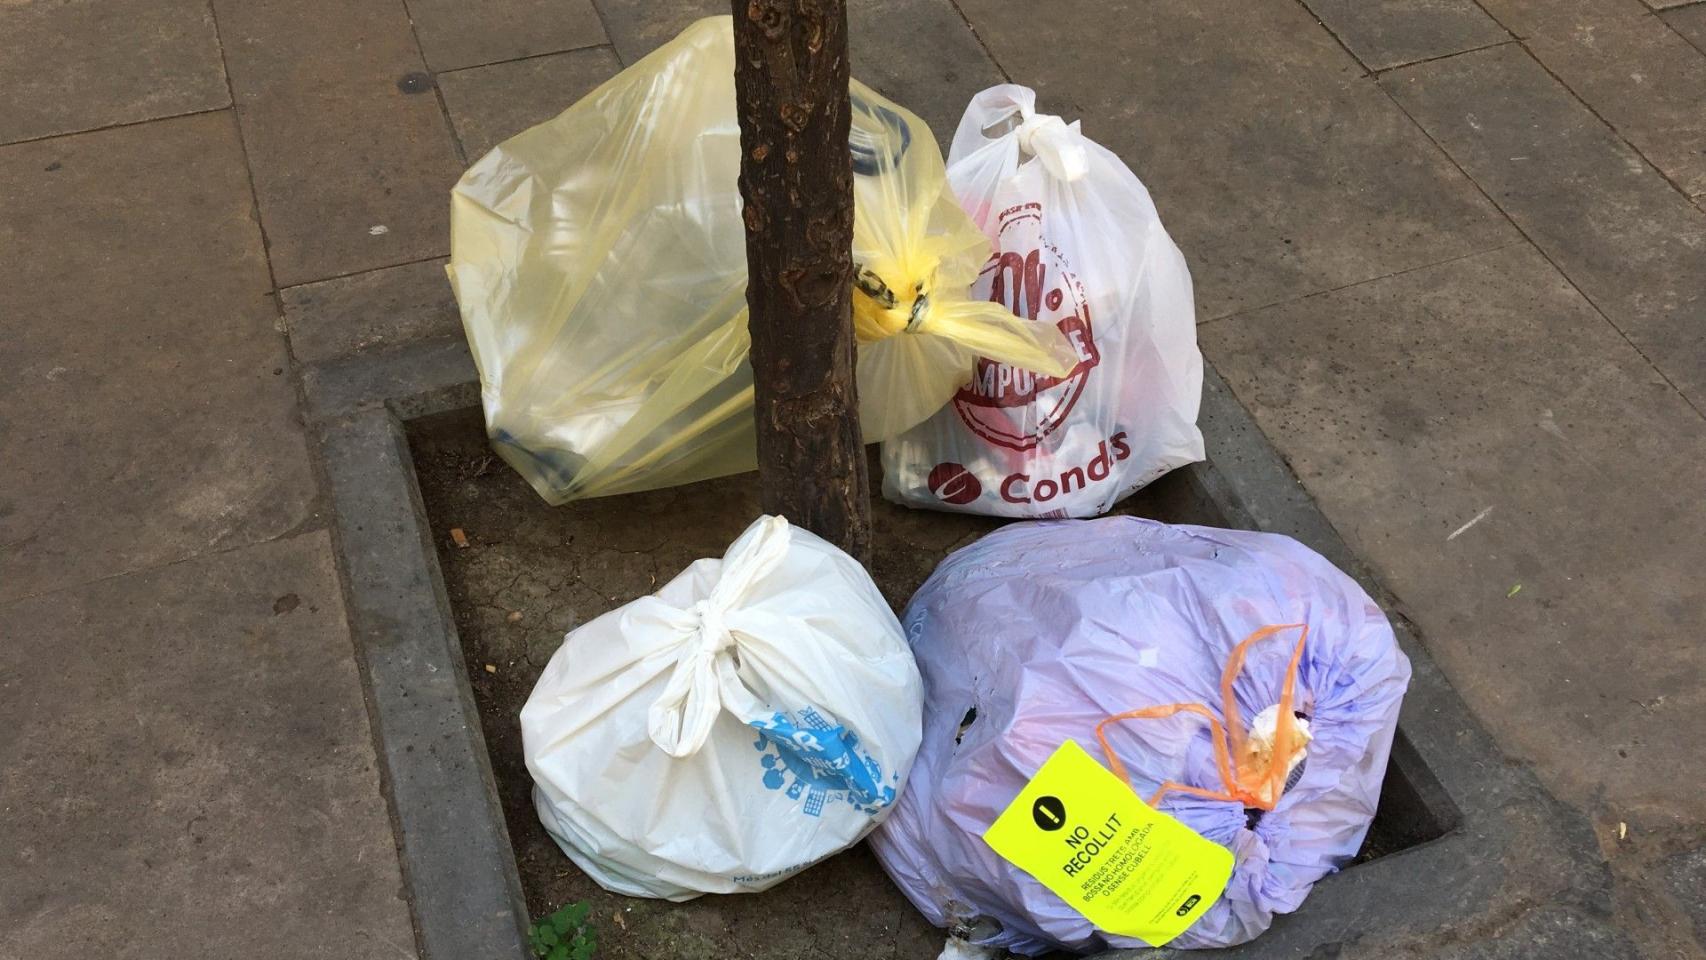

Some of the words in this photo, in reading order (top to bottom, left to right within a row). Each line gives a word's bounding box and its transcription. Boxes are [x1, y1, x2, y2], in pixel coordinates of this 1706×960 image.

[1000, 431, 1131, 504] Conds
[1063, 813, 1122, 878] RECOLLIT
[1065, 825, 1090, 850] NO
[1083, 881, 1105, 903] BOSSA
[1101, 871, 1115, 886] NO
[1112, 822, 1154, 877] HOMOLOGADA
[1081, 865, 1109, 891] RESIDUS
[1105, 845, 1127, 869] TRETS
[1108, 872, 1130, 893] SENSE
[1126, 845, 1152, 873] CUBELL
